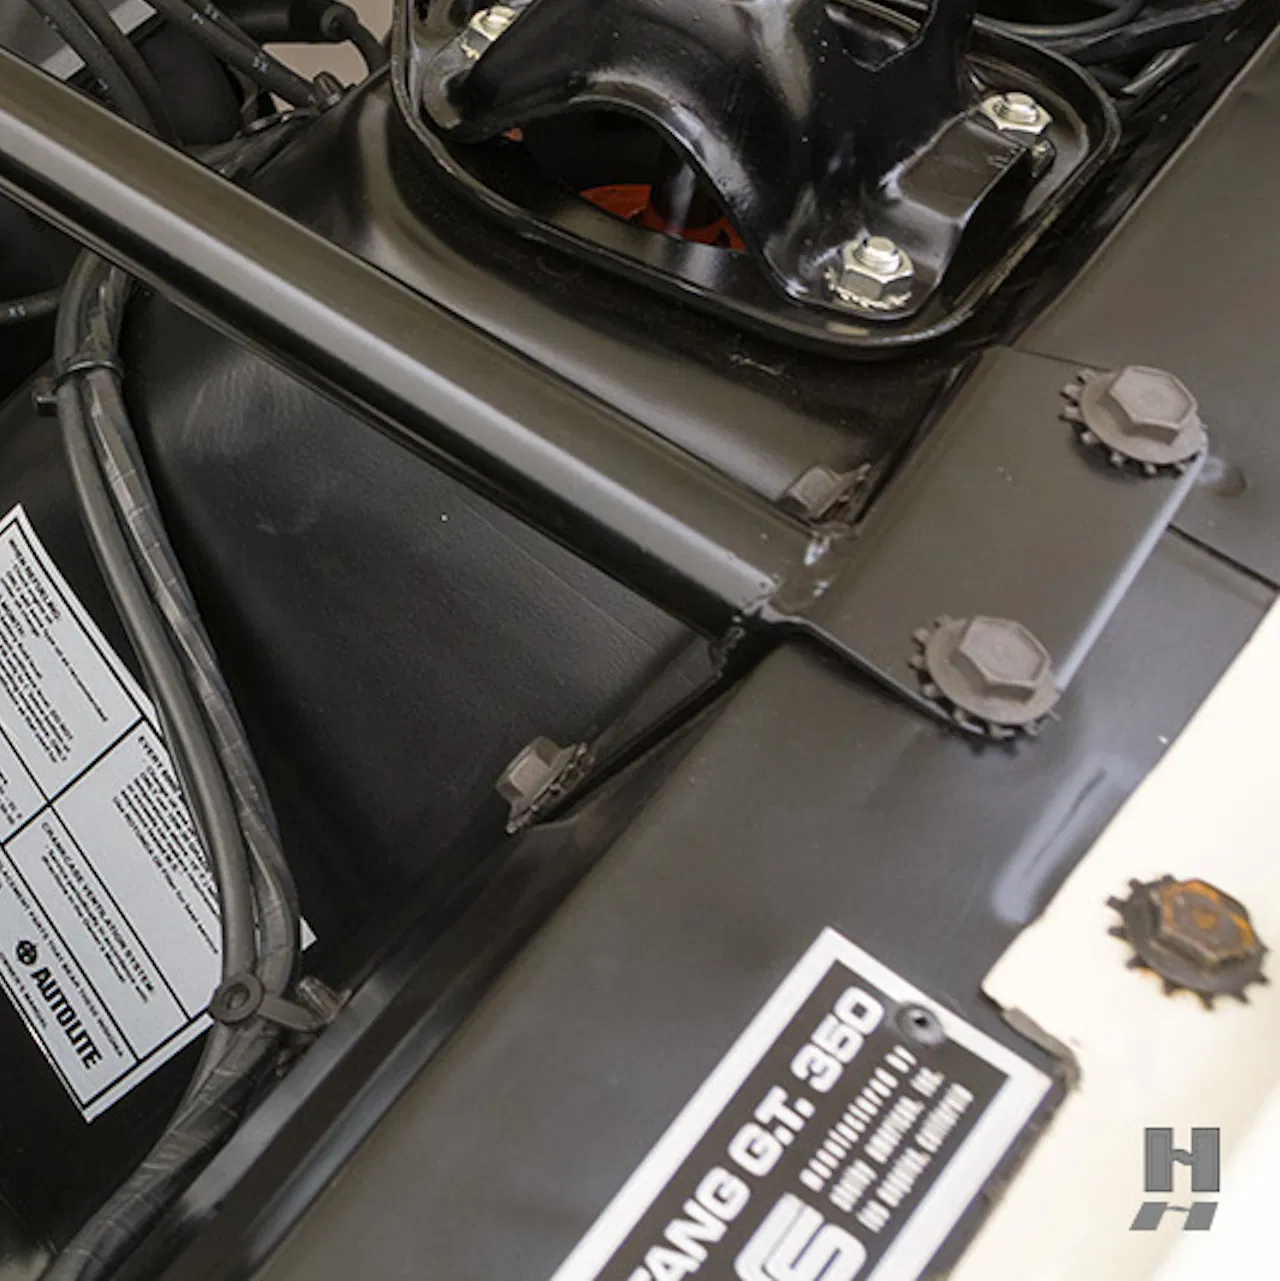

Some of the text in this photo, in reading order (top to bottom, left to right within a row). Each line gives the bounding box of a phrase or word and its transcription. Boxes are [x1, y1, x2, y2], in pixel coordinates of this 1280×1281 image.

[27, 962, 105, 1071] AUTOLITE
[727, 1084, 817, 1178] G.T.
[789, 985, 886, 1094] 350
